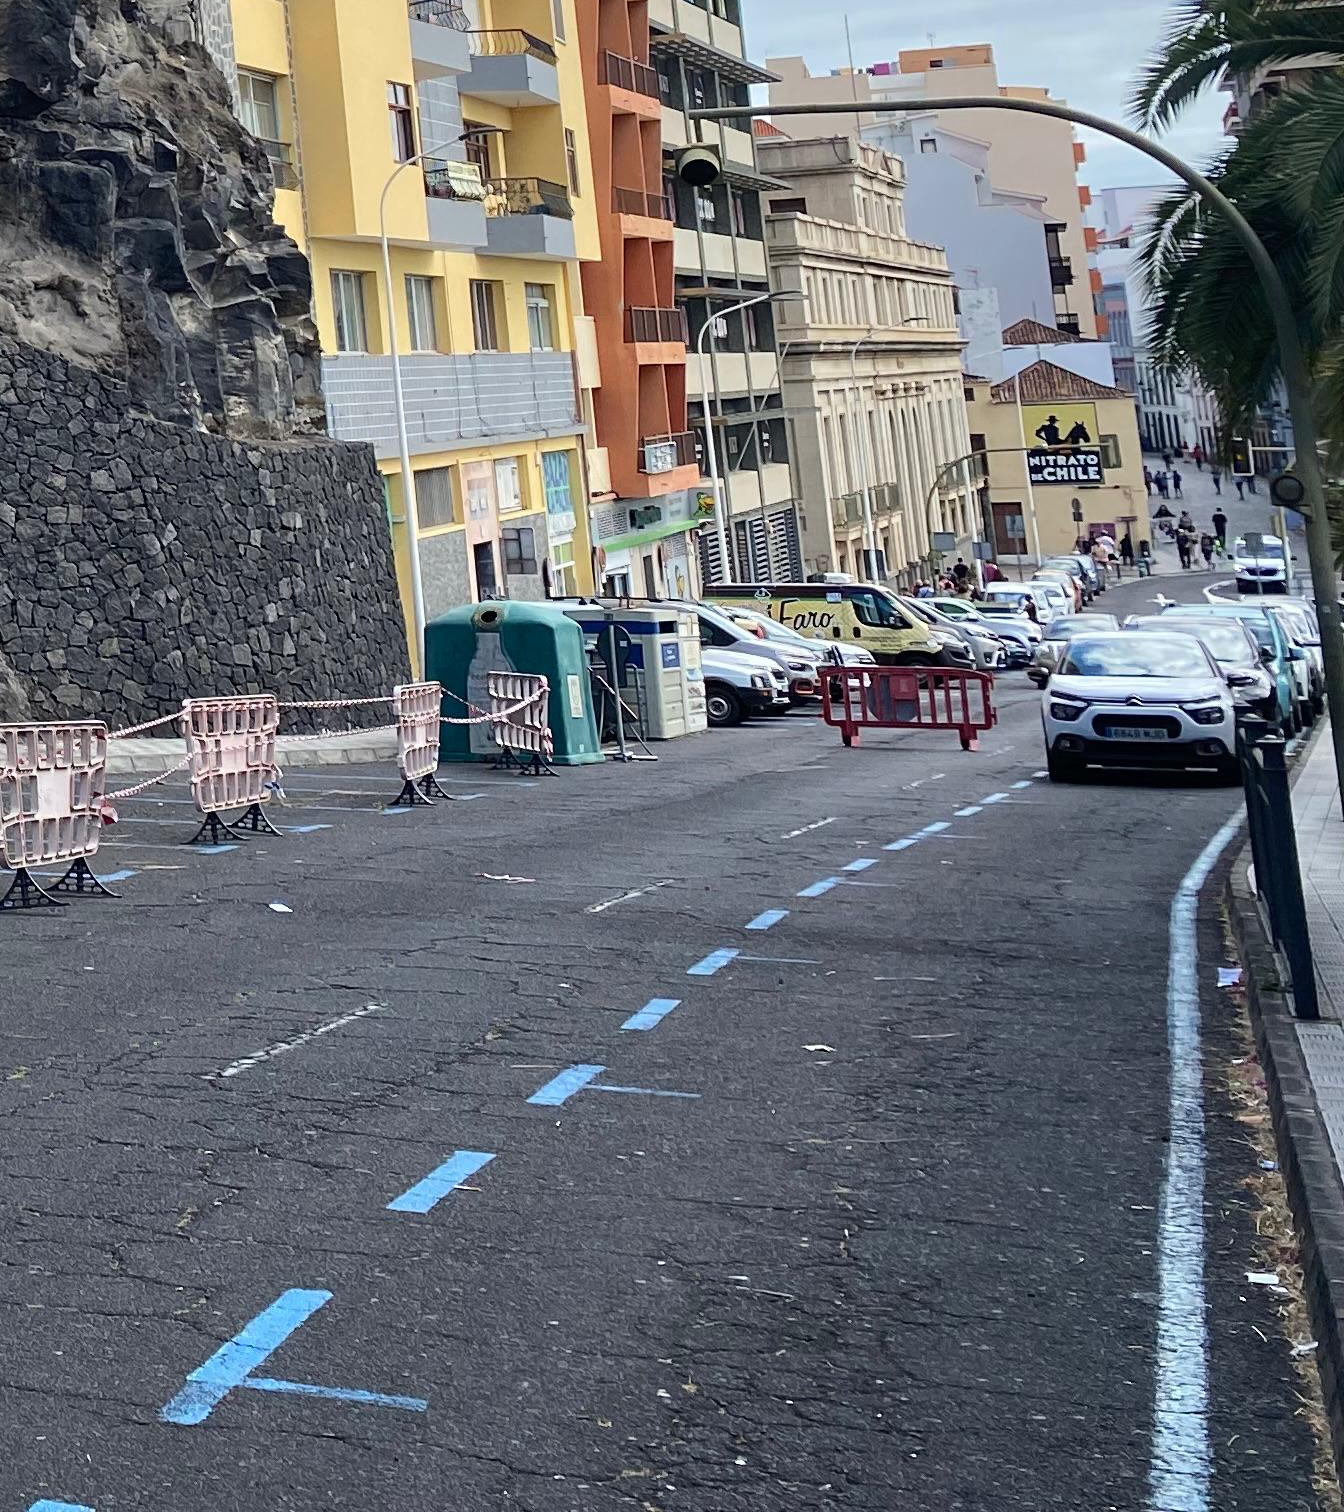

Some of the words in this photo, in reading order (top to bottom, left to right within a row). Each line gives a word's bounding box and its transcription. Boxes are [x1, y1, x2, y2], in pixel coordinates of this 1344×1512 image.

[1029, 454, 1099, 467] NITRATO
[1042, 466, 1101, 481] CHILE
[778, 597, 836, 631] Faro
